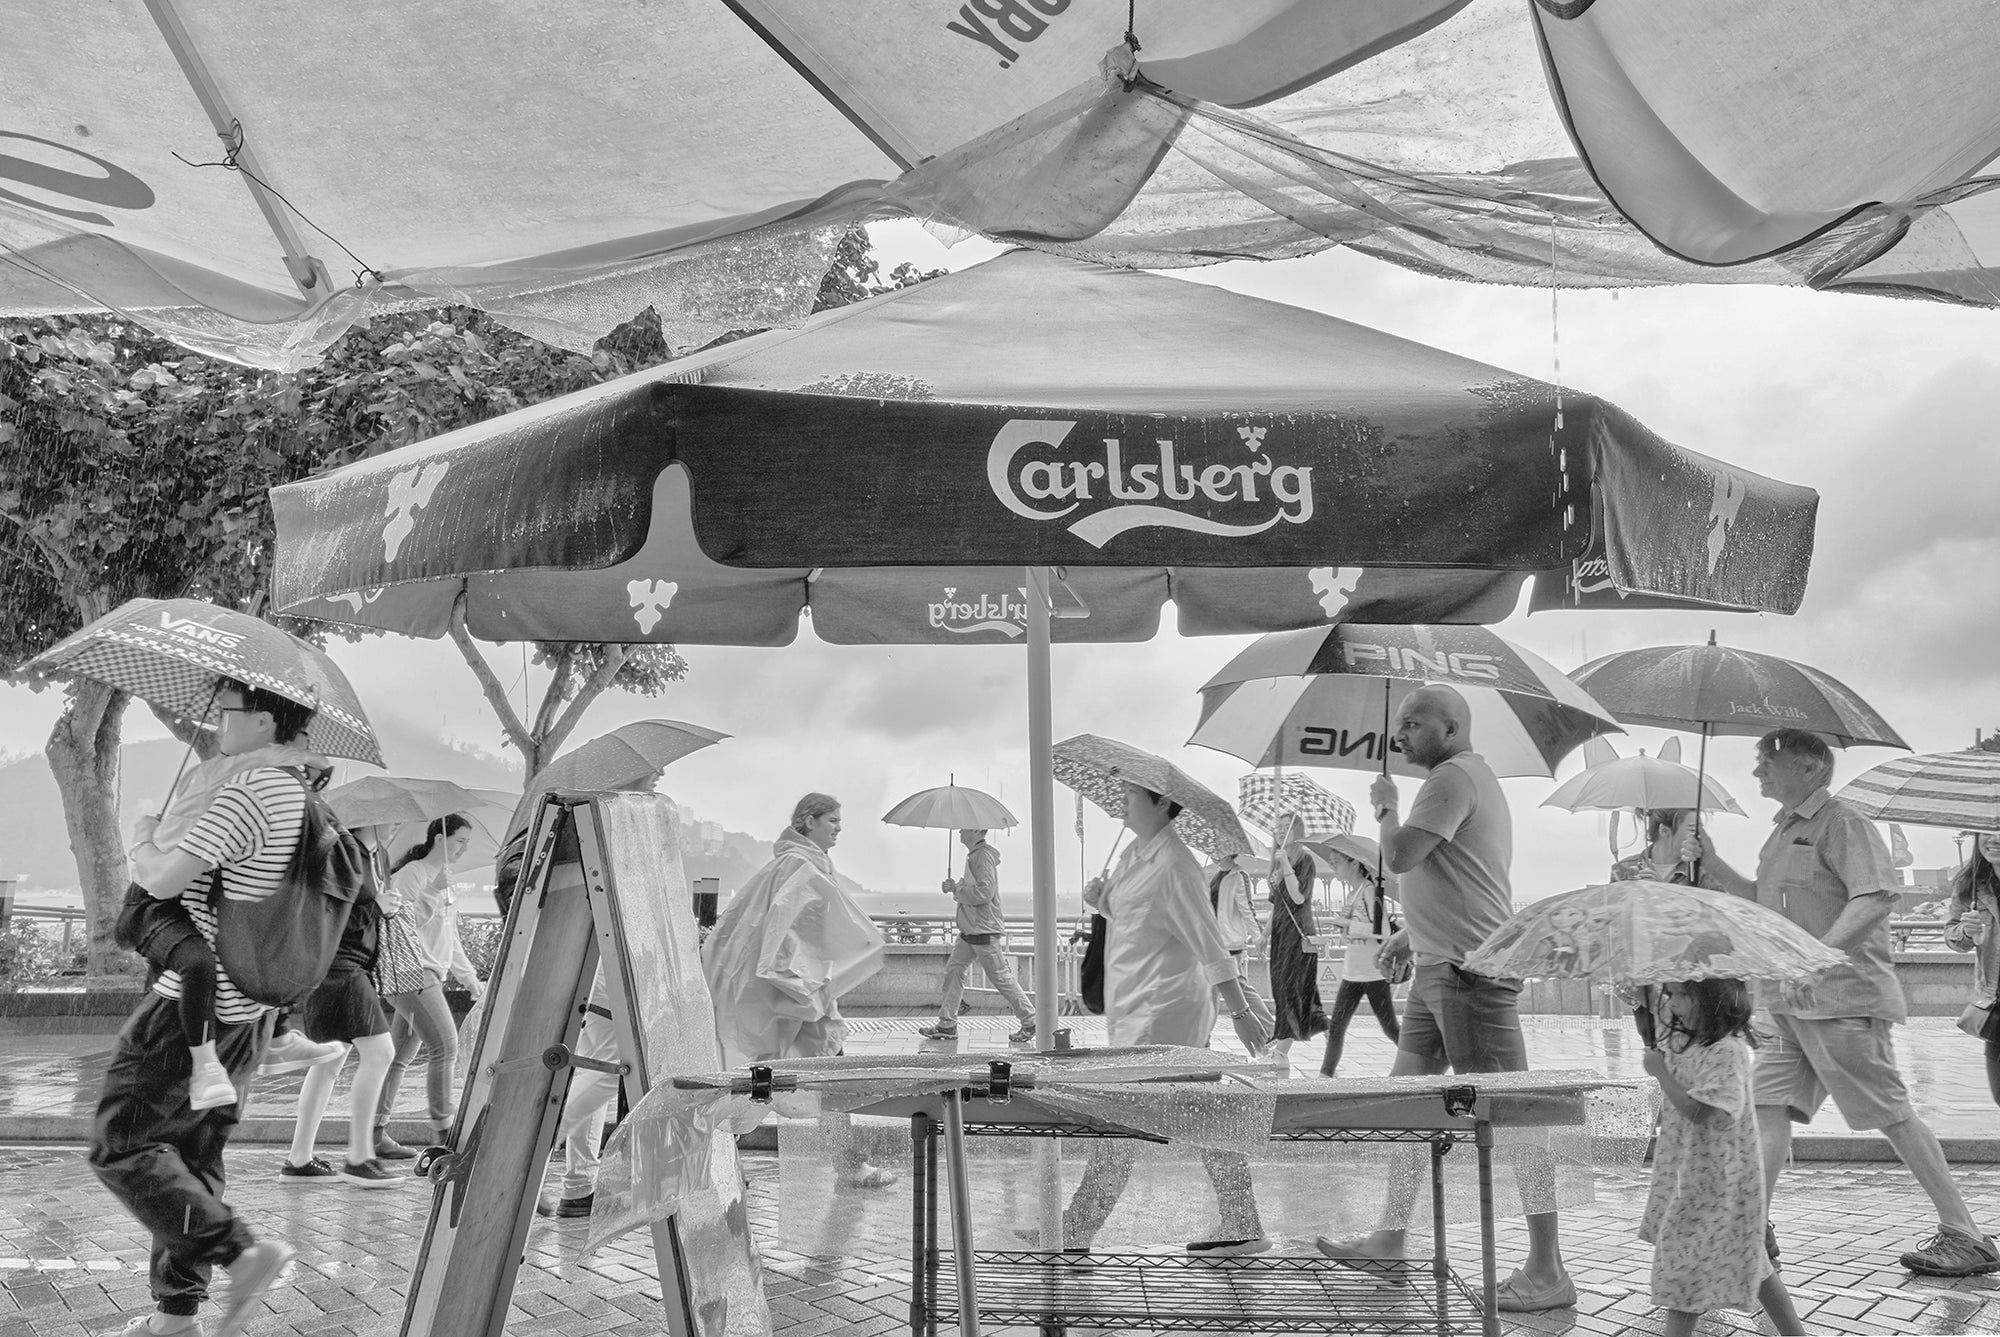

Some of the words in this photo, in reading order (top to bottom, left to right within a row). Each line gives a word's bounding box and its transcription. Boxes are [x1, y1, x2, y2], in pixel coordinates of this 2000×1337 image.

[987, 419, 1314, 547] Carlsberg
[160, 611, 247, 648] VANS
[169, 633, 200, 648] THE
[1343, 641, 1500, 680] PING
[1729, 701, 1763, 715] Jack
[1764, 703, 1808, 719] Wills
